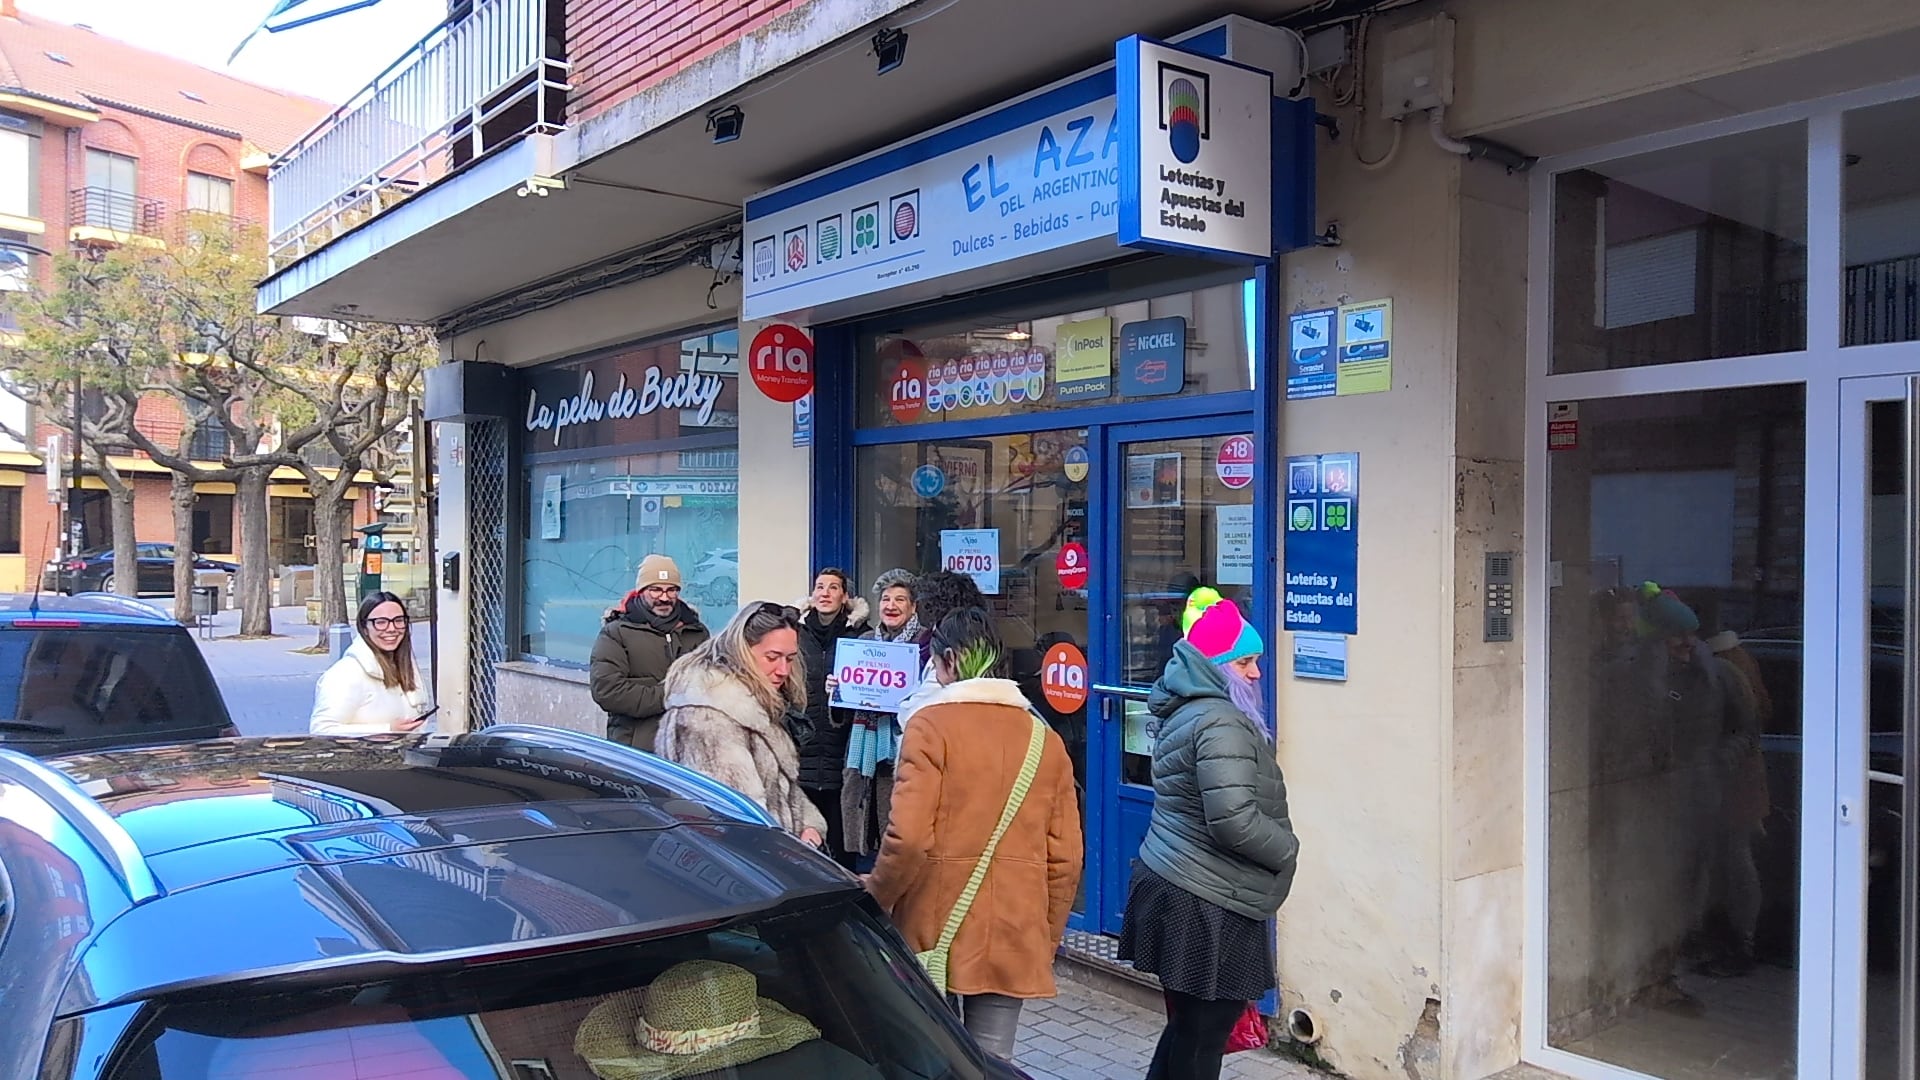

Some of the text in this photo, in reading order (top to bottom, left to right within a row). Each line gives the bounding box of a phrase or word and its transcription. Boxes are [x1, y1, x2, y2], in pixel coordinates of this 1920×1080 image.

[962, 155, 1009, 212] EL
[1160, 165, 1225, 196] Loterías y
[1000, 195, 1025, 217] DEL
[1161, 188, 1245, 217] Apuestas del
[1160, 210, 1206, 232] Estado
[952, 233, 995, 256] Dulces
[1014, 213, 1069, 240] Bebidas
[1074, 336, 1104, 352] InPost
[757, 333, 808, 373] ria
[993, 354, 1007, 368] ria
[1010, 352, 1025, 366] ria
[1028, 349, 1043, 363] ria
[928, 364, 941, 378] ria
[944, 362, 957, 375] ria
[960, 359, 973, 373] ria
[976, 356, 990, 370] ria
[757, 373, 809, 385] Money Transfer
[893, 369, 921, 401] ria
[1060, 382, 1106, 396] Punto Pack
[527, 389, 554, 431] La
[553, 370, 604, 446] pelu
[609, 373, 638, 418] de
[1225, 441, 1248, 458] +18
[371, 536, 380, 547] P
[947, 555, 992, 572] 06703
[1058, 566, 1087, 577] MoneyGram
[1286, 572, 1338, 590] Loterías y
[1286, 592, 1353, 607] Apuestas del
[1286, 610, 1322, 625] Estado
[841, 665, 907, 689] 06703
[1046, 651, 1083, 690] ria
[1046, 688, 1083, 700] Money Transfer
